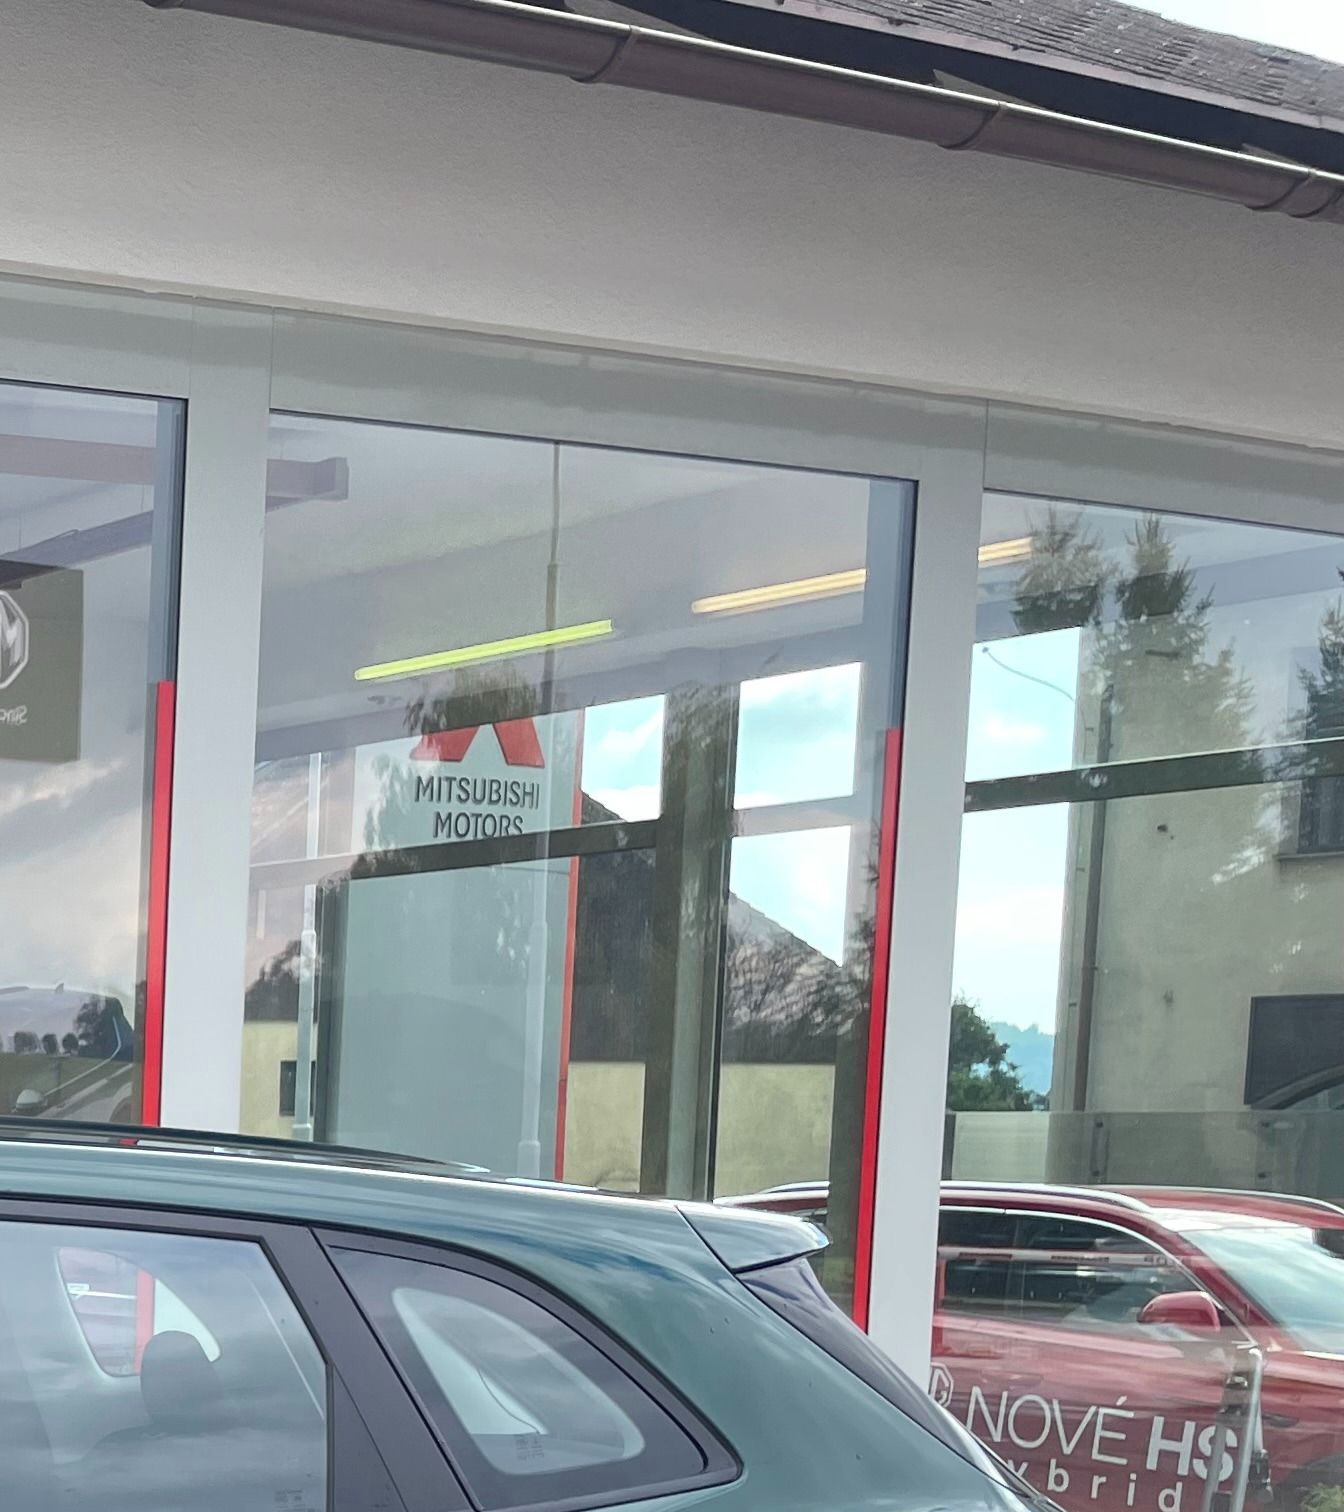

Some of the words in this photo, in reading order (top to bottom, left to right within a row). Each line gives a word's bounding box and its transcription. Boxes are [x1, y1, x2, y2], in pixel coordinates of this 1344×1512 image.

[414, 775, 540, 809] MITSUBISHI
[433, 811, 524, 839] MOTORS
[965, 1385, 1135, 1466] NOVÉ
[1146, 1415, 1238, 1483] HS
